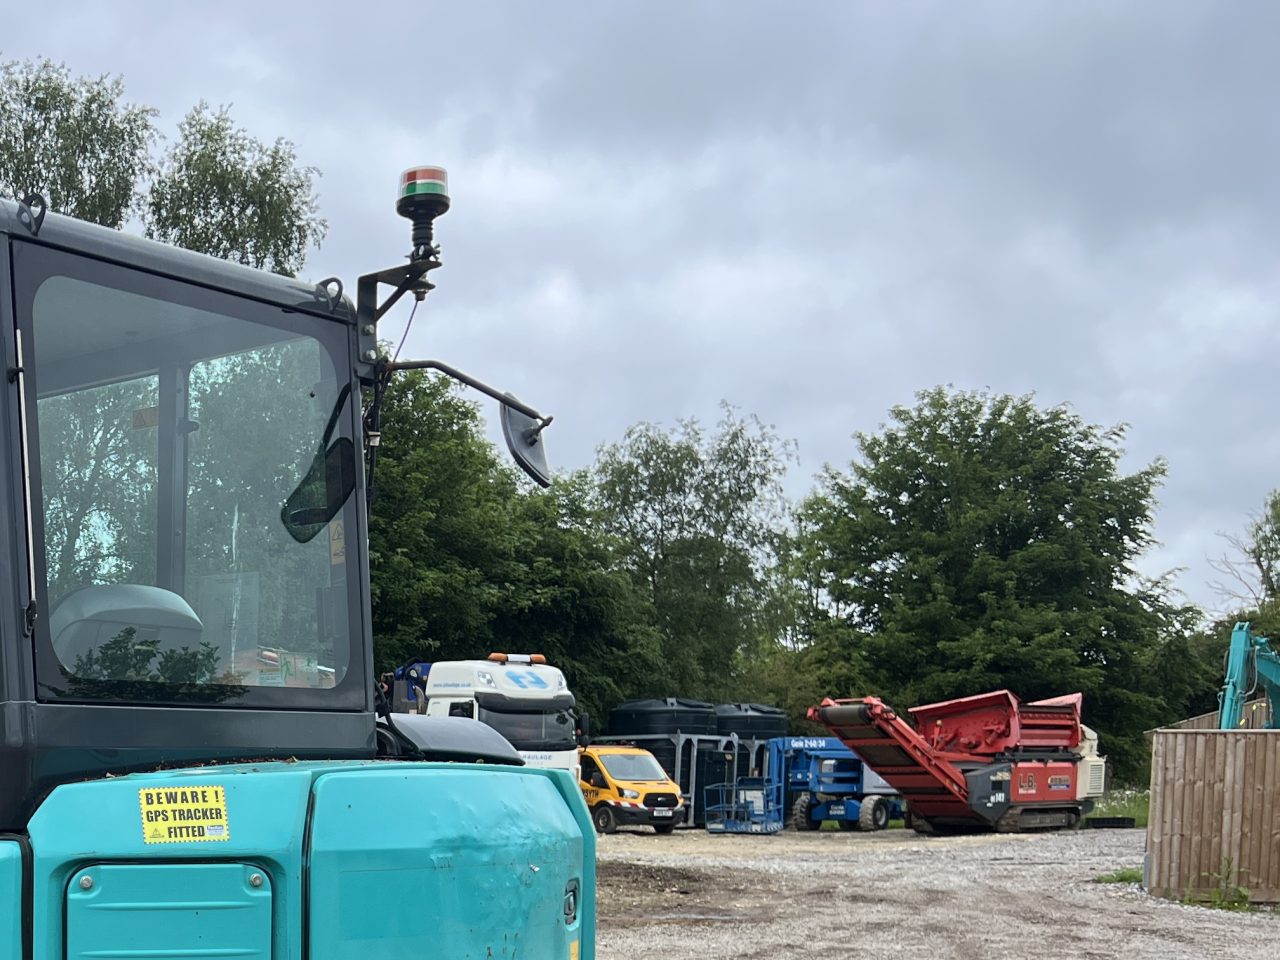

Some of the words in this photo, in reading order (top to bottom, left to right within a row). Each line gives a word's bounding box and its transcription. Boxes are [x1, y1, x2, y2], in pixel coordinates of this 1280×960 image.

[145, 791, 208, 805] BEWARE
[214, 790, 220, 803] !
[146, 809, 169, 822] GPS
[171, 808, 223, 821] TRACKER
[167, 825, 205, 838] FITTED
